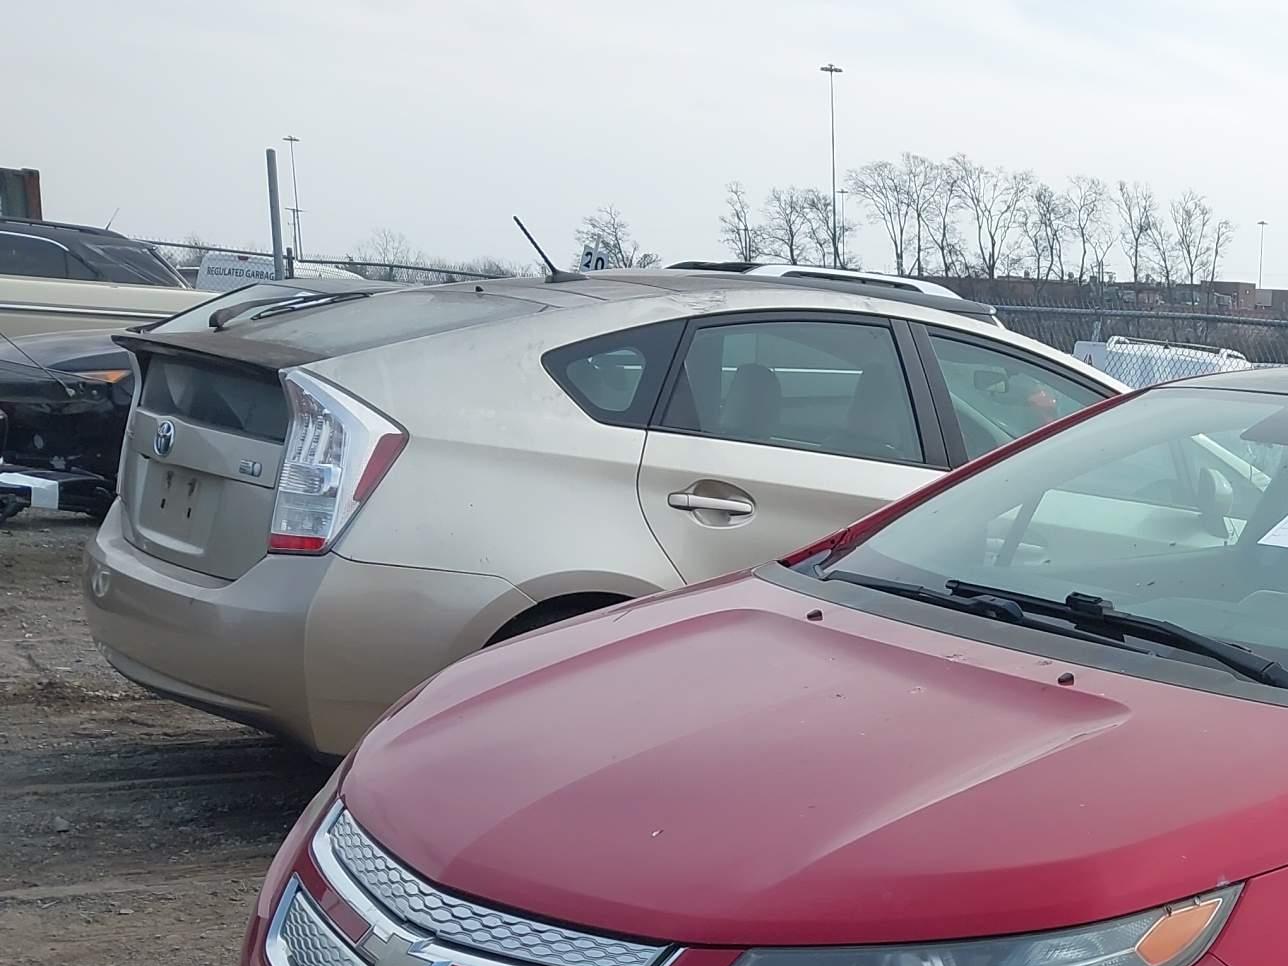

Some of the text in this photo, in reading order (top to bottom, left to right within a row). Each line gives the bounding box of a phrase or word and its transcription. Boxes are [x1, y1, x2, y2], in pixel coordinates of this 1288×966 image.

[583, 251, 605, 270] 20
[207, 266, 275, 281] REGULATED GARBAG
